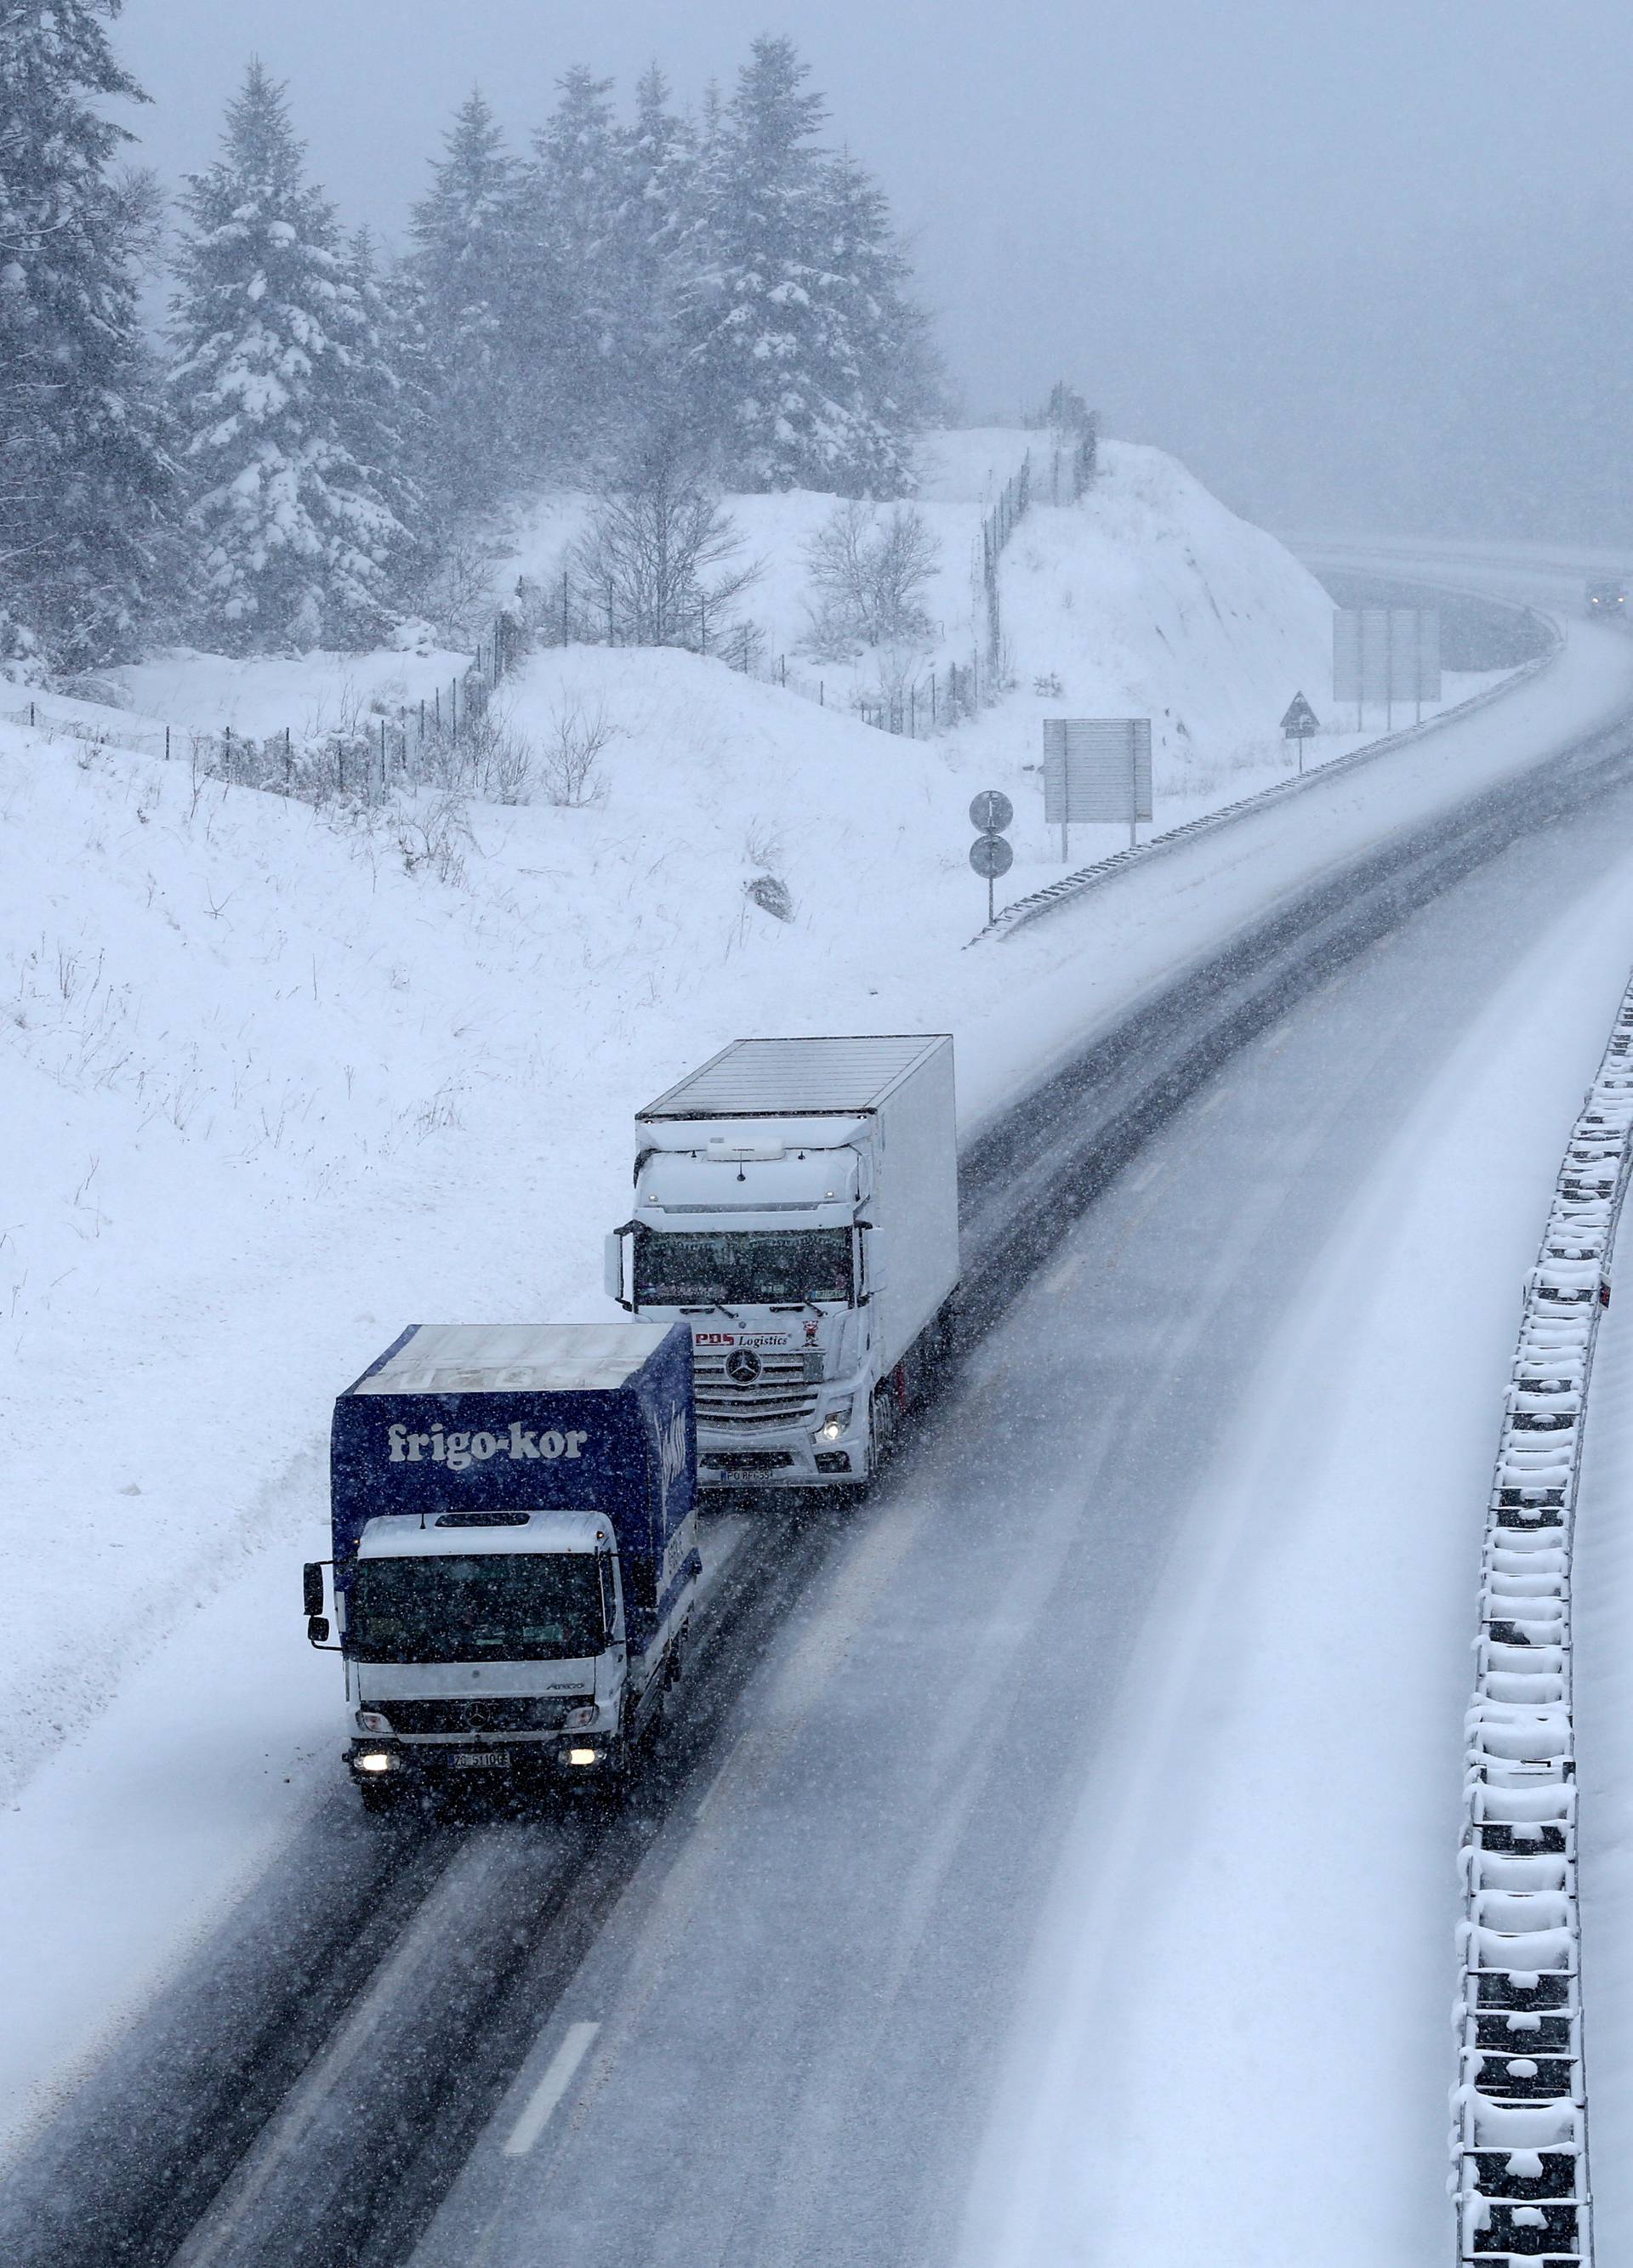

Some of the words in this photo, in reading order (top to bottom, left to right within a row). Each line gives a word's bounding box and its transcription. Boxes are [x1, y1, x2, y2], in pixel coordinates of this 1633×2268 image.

[696, 1333, 735, 1346] PDS
[738, 1335, 788, 1348] Logistics
[388, 1421, 588, 1470] frigo-kor
